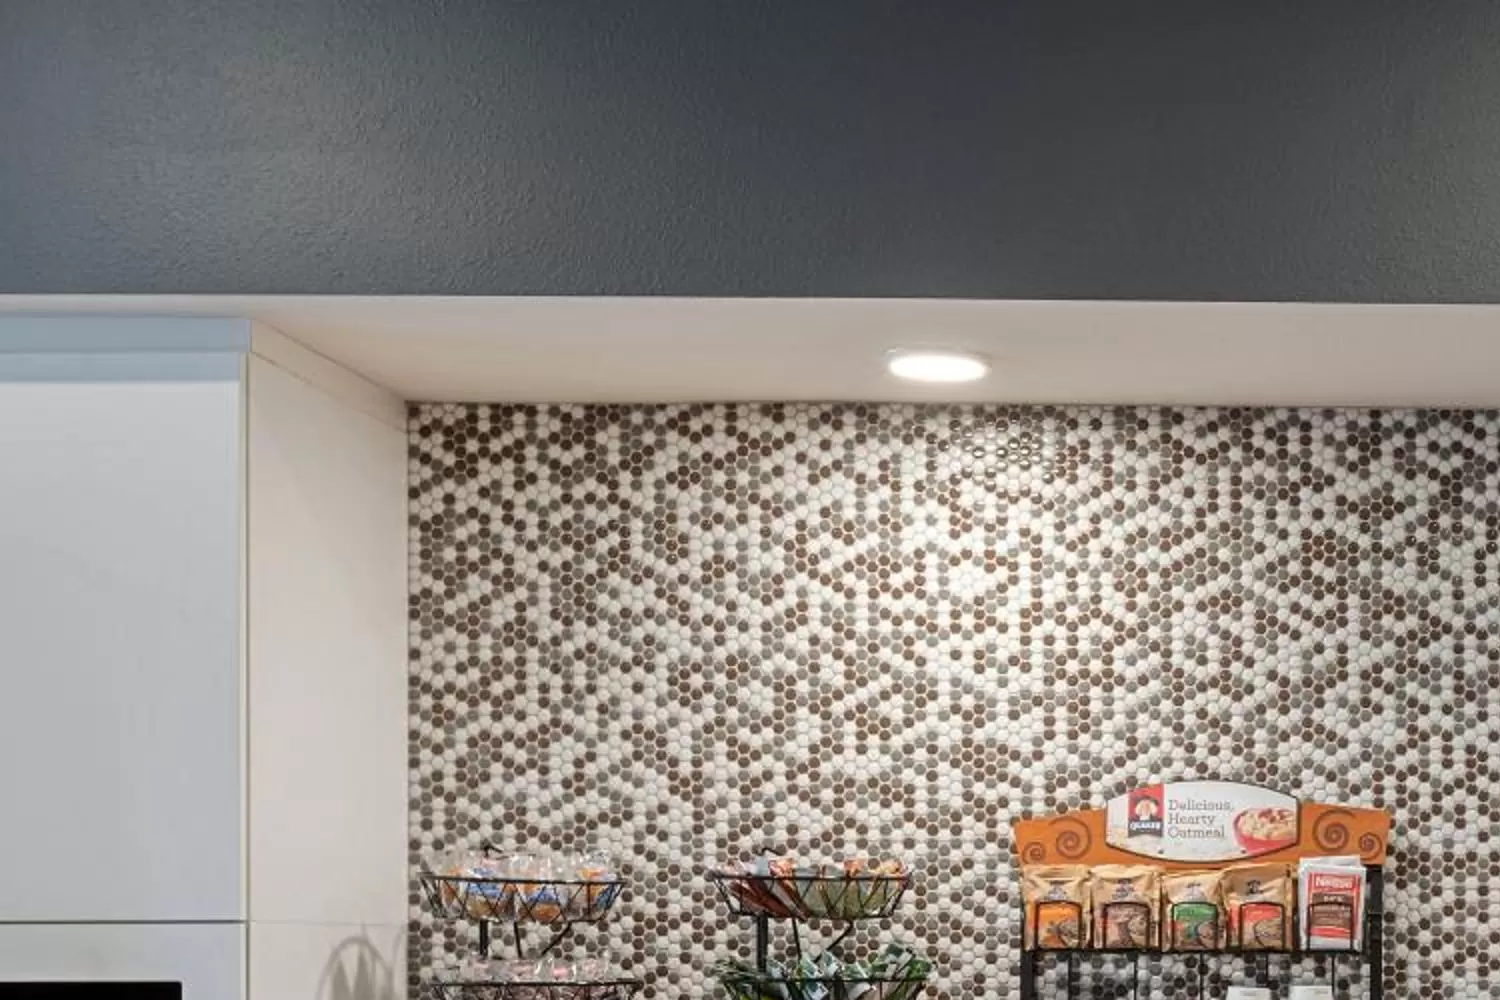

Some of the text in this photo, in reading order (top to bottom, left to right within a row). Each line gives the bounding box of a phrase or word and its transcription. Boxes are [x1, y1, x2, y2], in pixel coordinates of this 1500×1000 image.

[1168, 798, 1235, 812] Delicious,
[1167, 813, 1216, 825] Hearty
[1167, 824, 1226, 838] Oatmeal
